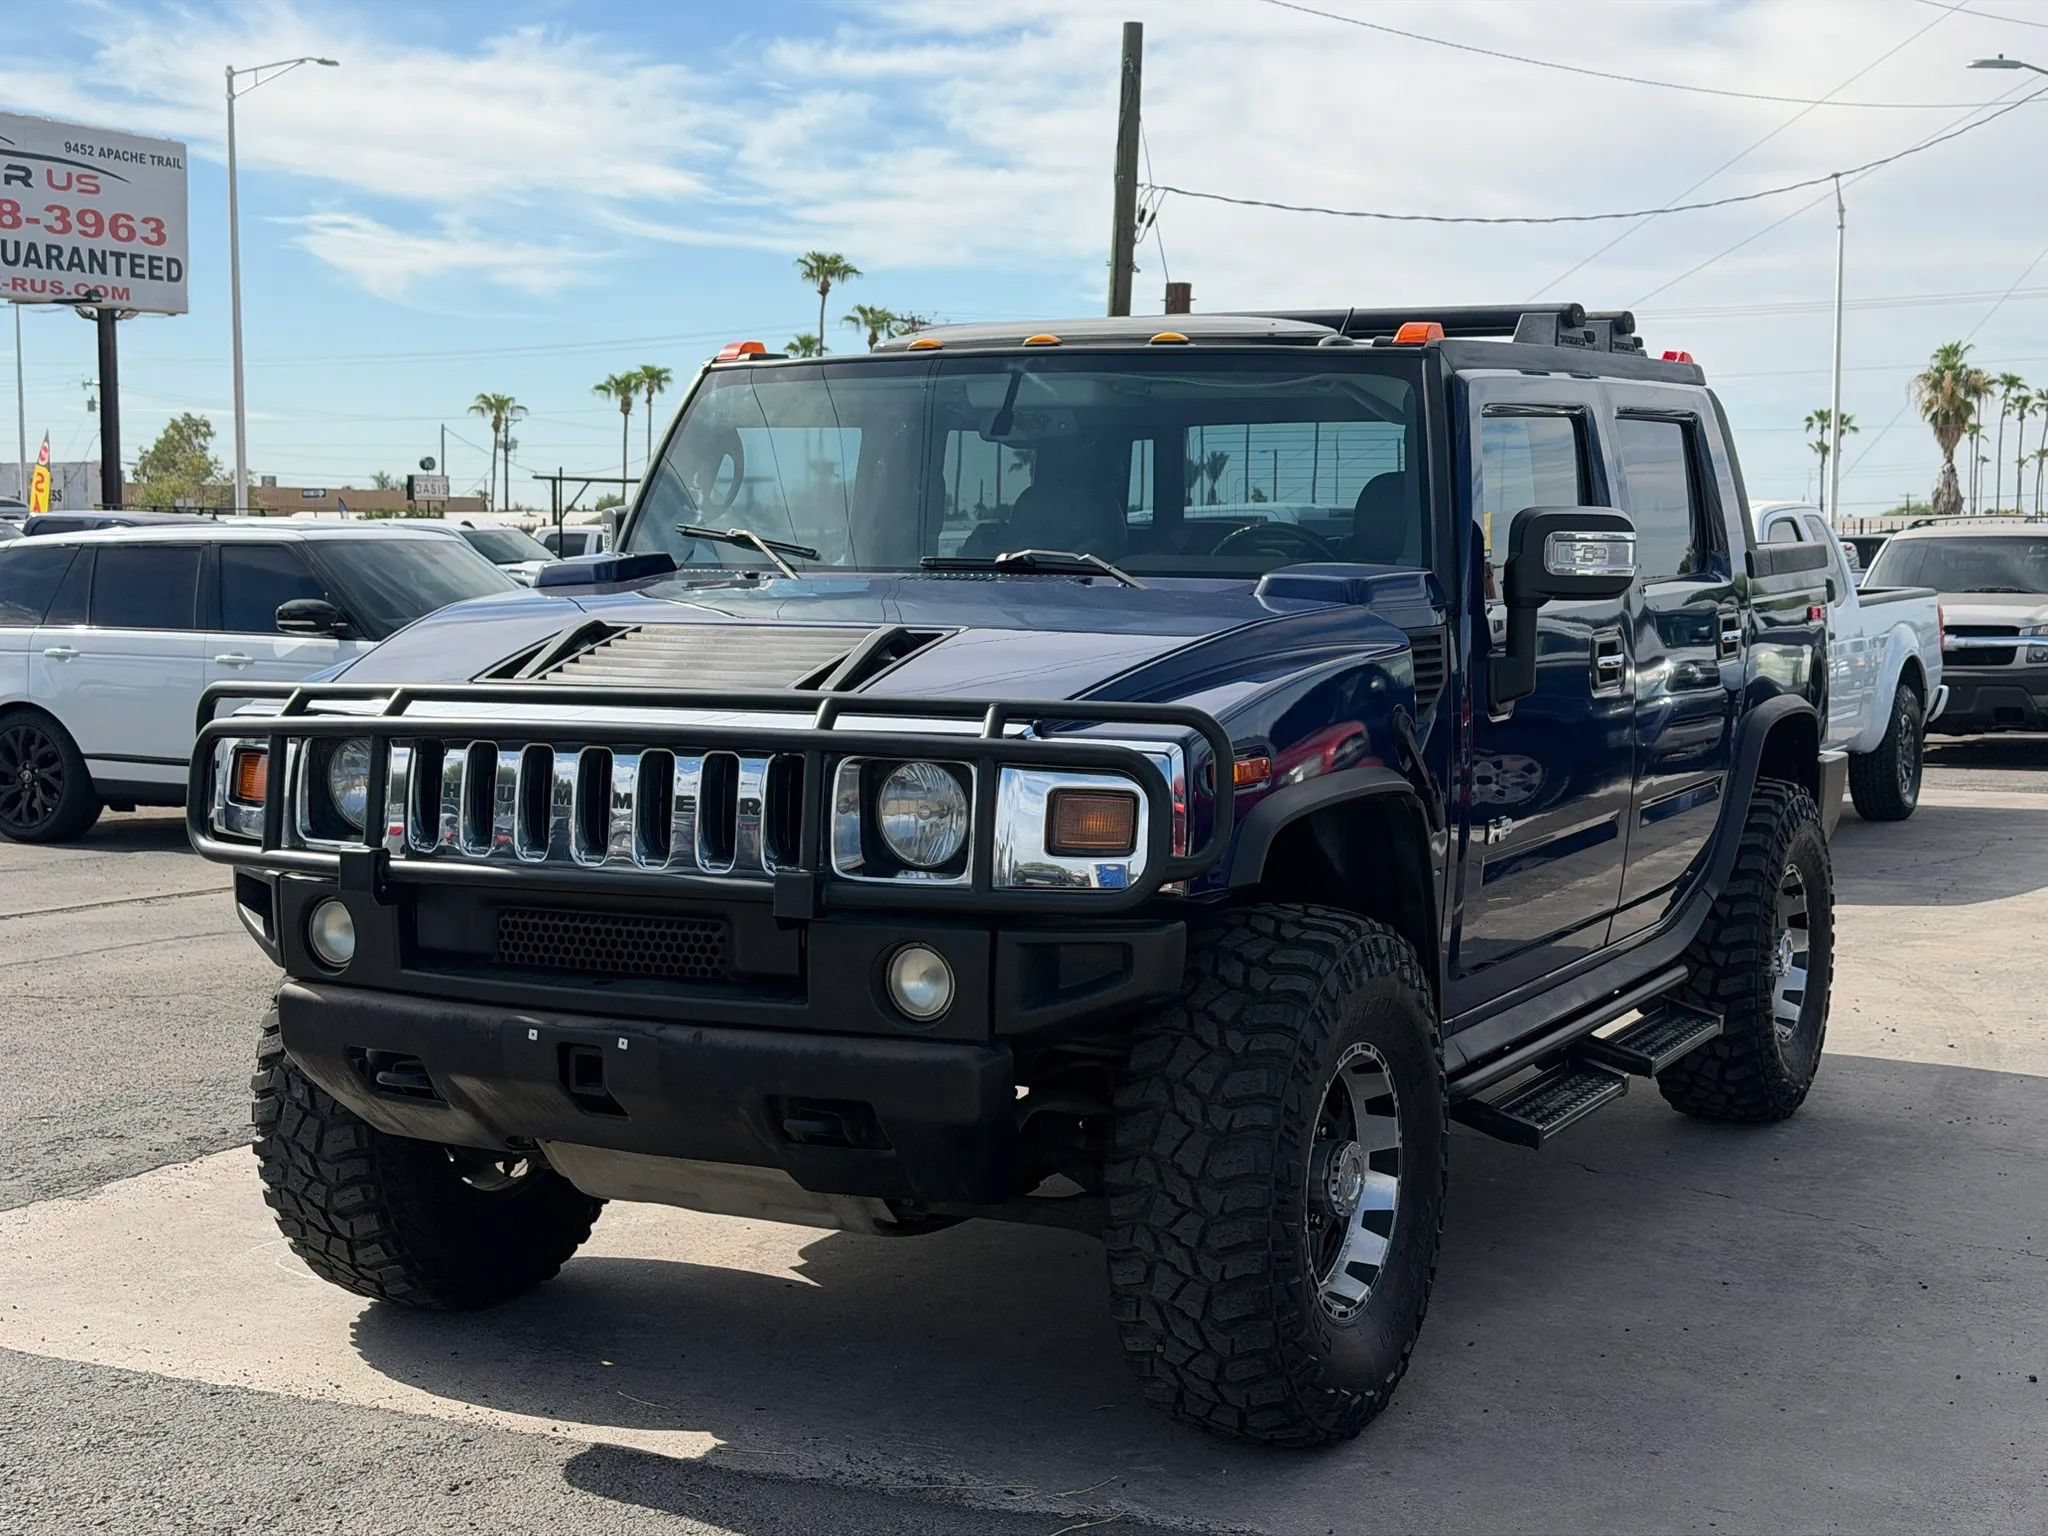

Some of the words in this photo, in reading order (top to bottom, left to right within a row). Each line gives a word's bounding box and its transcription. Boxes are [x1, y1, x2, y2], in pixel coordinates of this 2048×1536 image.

[64, 141, 95, 157] 9452
[98, 147, 147, 165] APACHE
[149, 154, 183, 170] TRAIL
[4, 163, 34, 189] R
[46, 168, 101, 195] US
[0, 198, 168, 247] 8-3963
[0, 277, 131, 301] -RUS.COM
[443, 780, 763, 815] HUMMER
